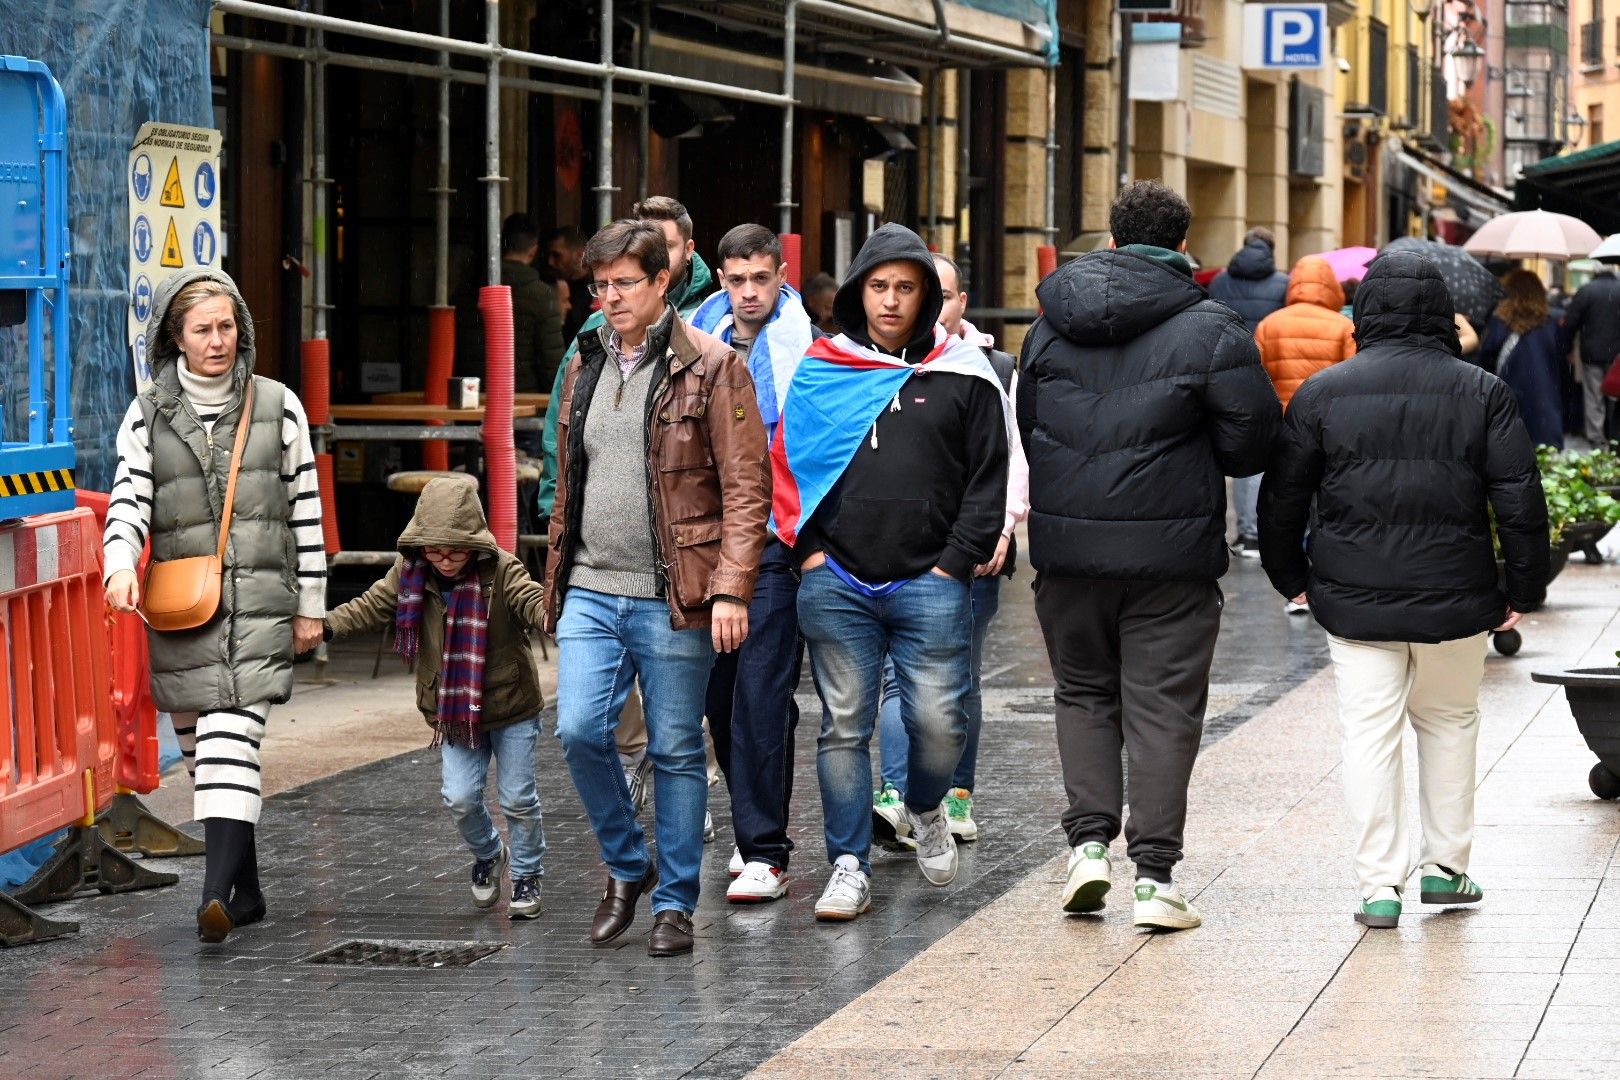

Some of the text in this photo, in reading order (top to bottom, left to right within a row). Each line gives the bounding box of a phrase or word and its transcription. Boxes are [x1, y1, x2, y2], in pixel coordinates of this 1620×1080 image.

[1271, 11, 1314, 62] P
[1285, 53, 1316, 63] HOTEL
[151, 128, 210, 142] ES OBLIGATORIO SEGUIR
[153, 139, 175, 149] NORMAS
[175, 141, 184, 150] DE
[184, 142, 212, 153] SEGURIDAD
